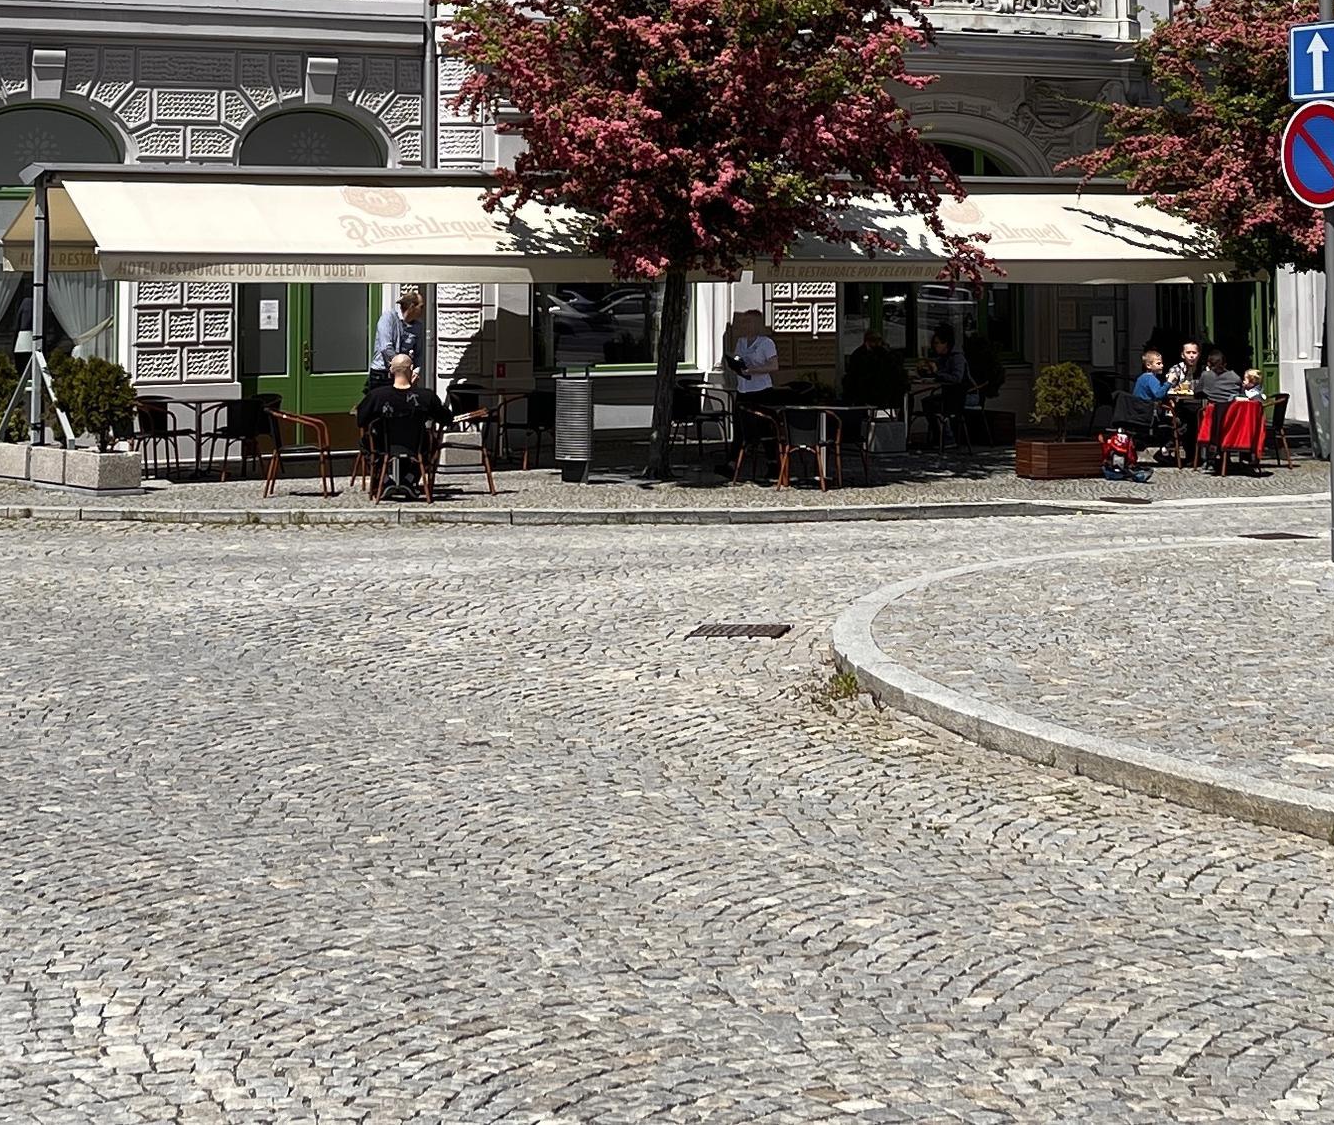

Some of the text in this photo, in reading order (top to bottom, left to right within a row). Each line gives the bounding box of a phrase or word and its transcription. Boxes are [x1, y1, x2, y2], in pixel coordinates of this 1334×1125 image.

[338, 214, 425, 248] Pilsner
[990, 221, 1068, 246] Urquell
[118, 261, 157, 276] HOTEL
[160, 262, 236, 276] RESTAURACE
[238, 264, 262, 277] POD
[324, 264, 366, 277] DUBEM
[797, 265, 858, 278] RESTAURACE
[858, 265, 878, 278] POD
